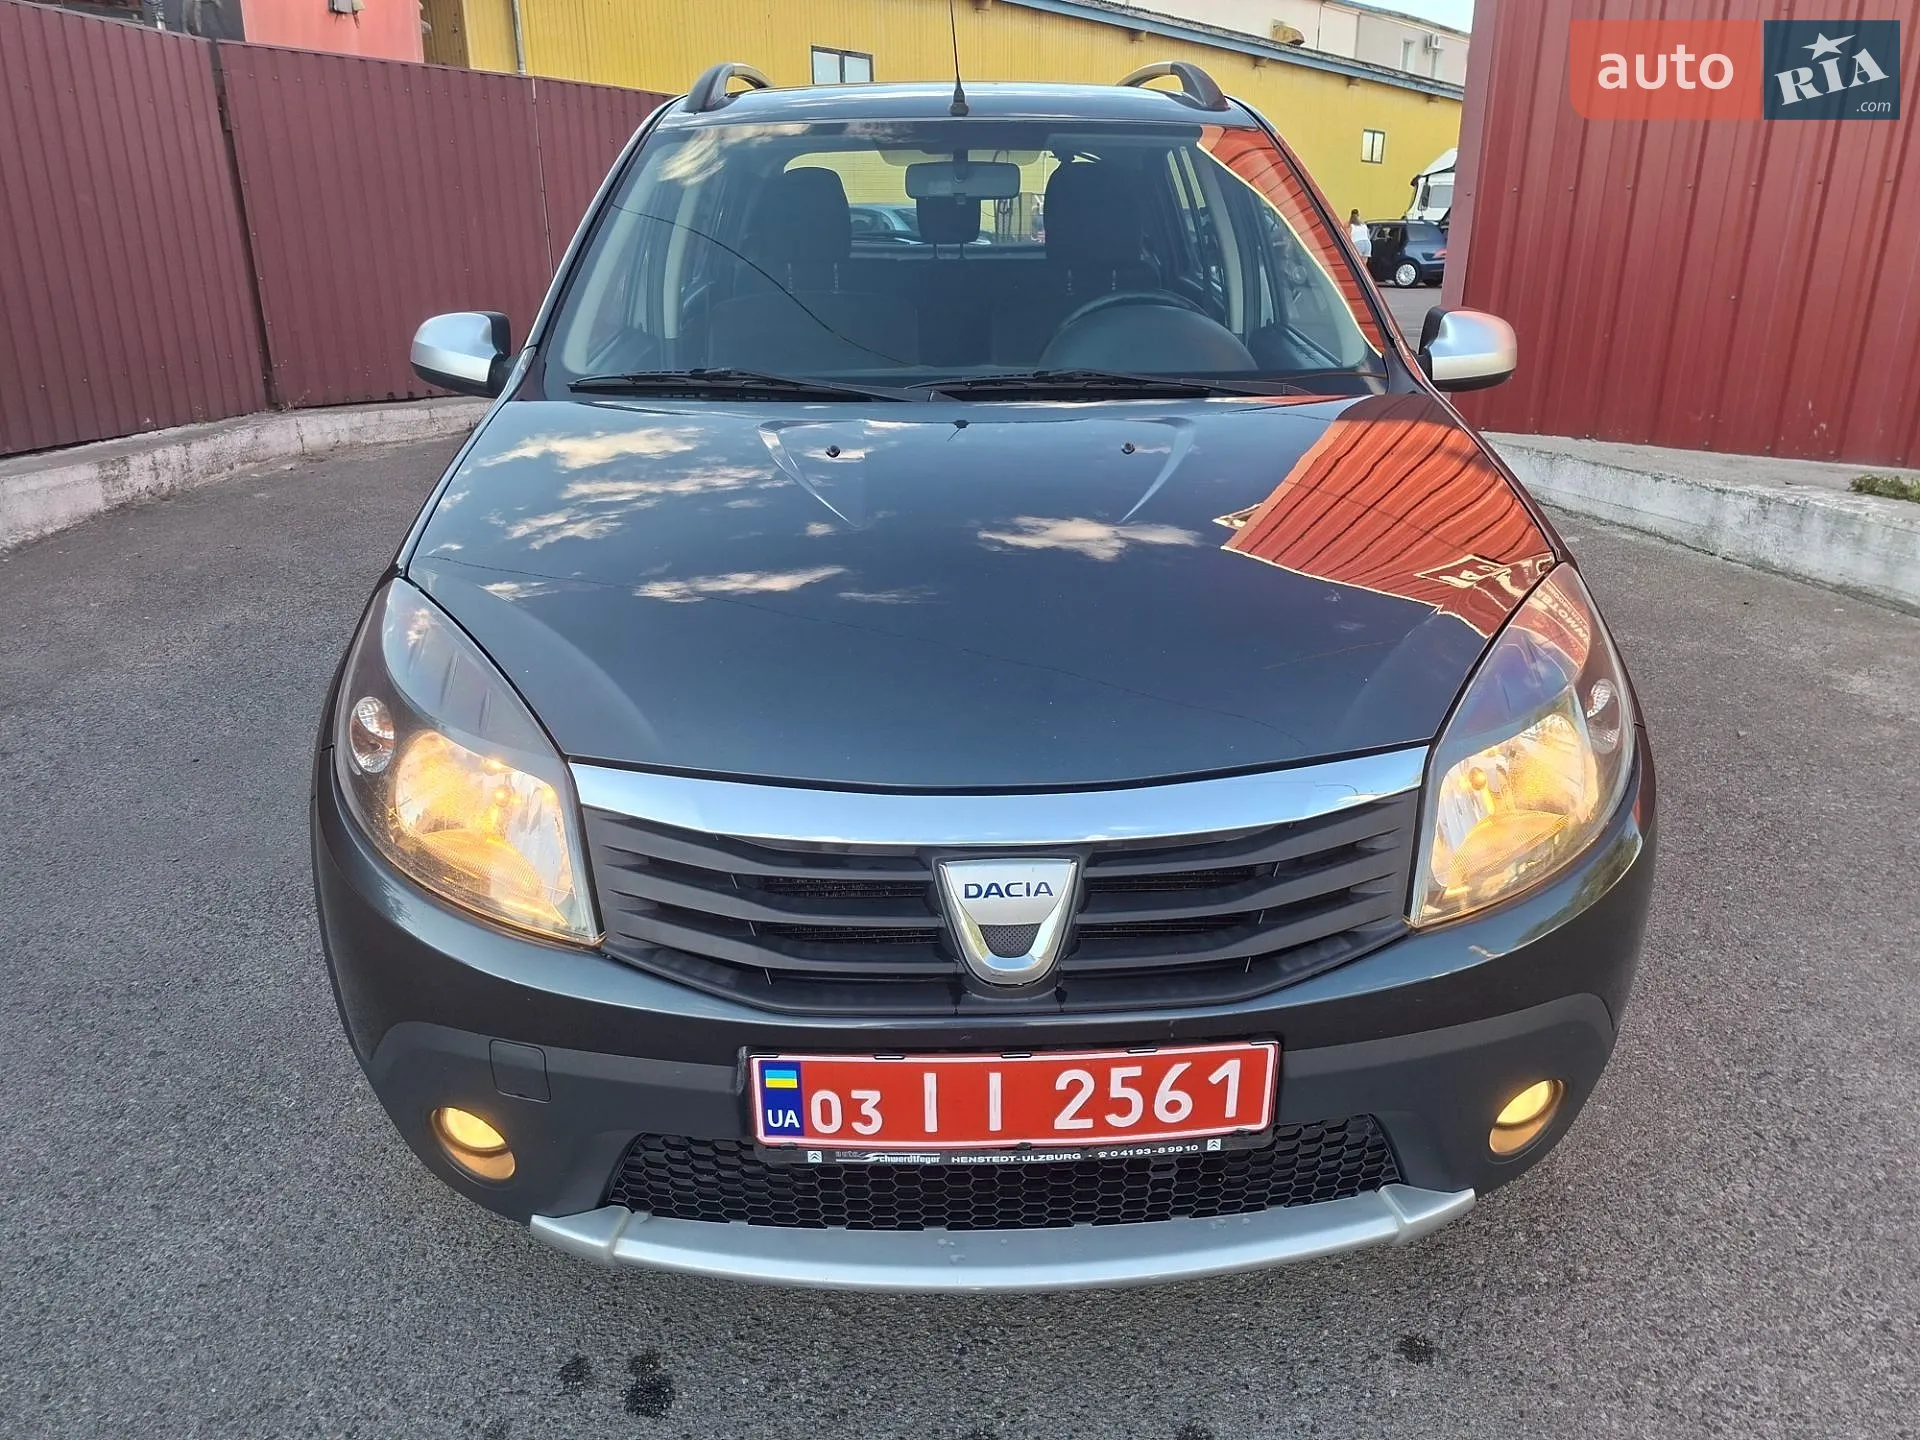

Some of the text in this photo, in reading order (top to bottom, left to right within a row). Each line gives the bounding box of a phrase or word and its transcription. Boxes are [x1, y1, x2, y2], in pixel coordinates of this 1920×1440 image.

[964, 881, 1054, 899] DACIA
[810, 1089, 883, 1135] 03
[1053, 1059, 1242, 1130] 2561
[767, 1109, 800, 1128] UA
[951, 1152, 1082, 1163] HENSTEDT-ULZBURG
